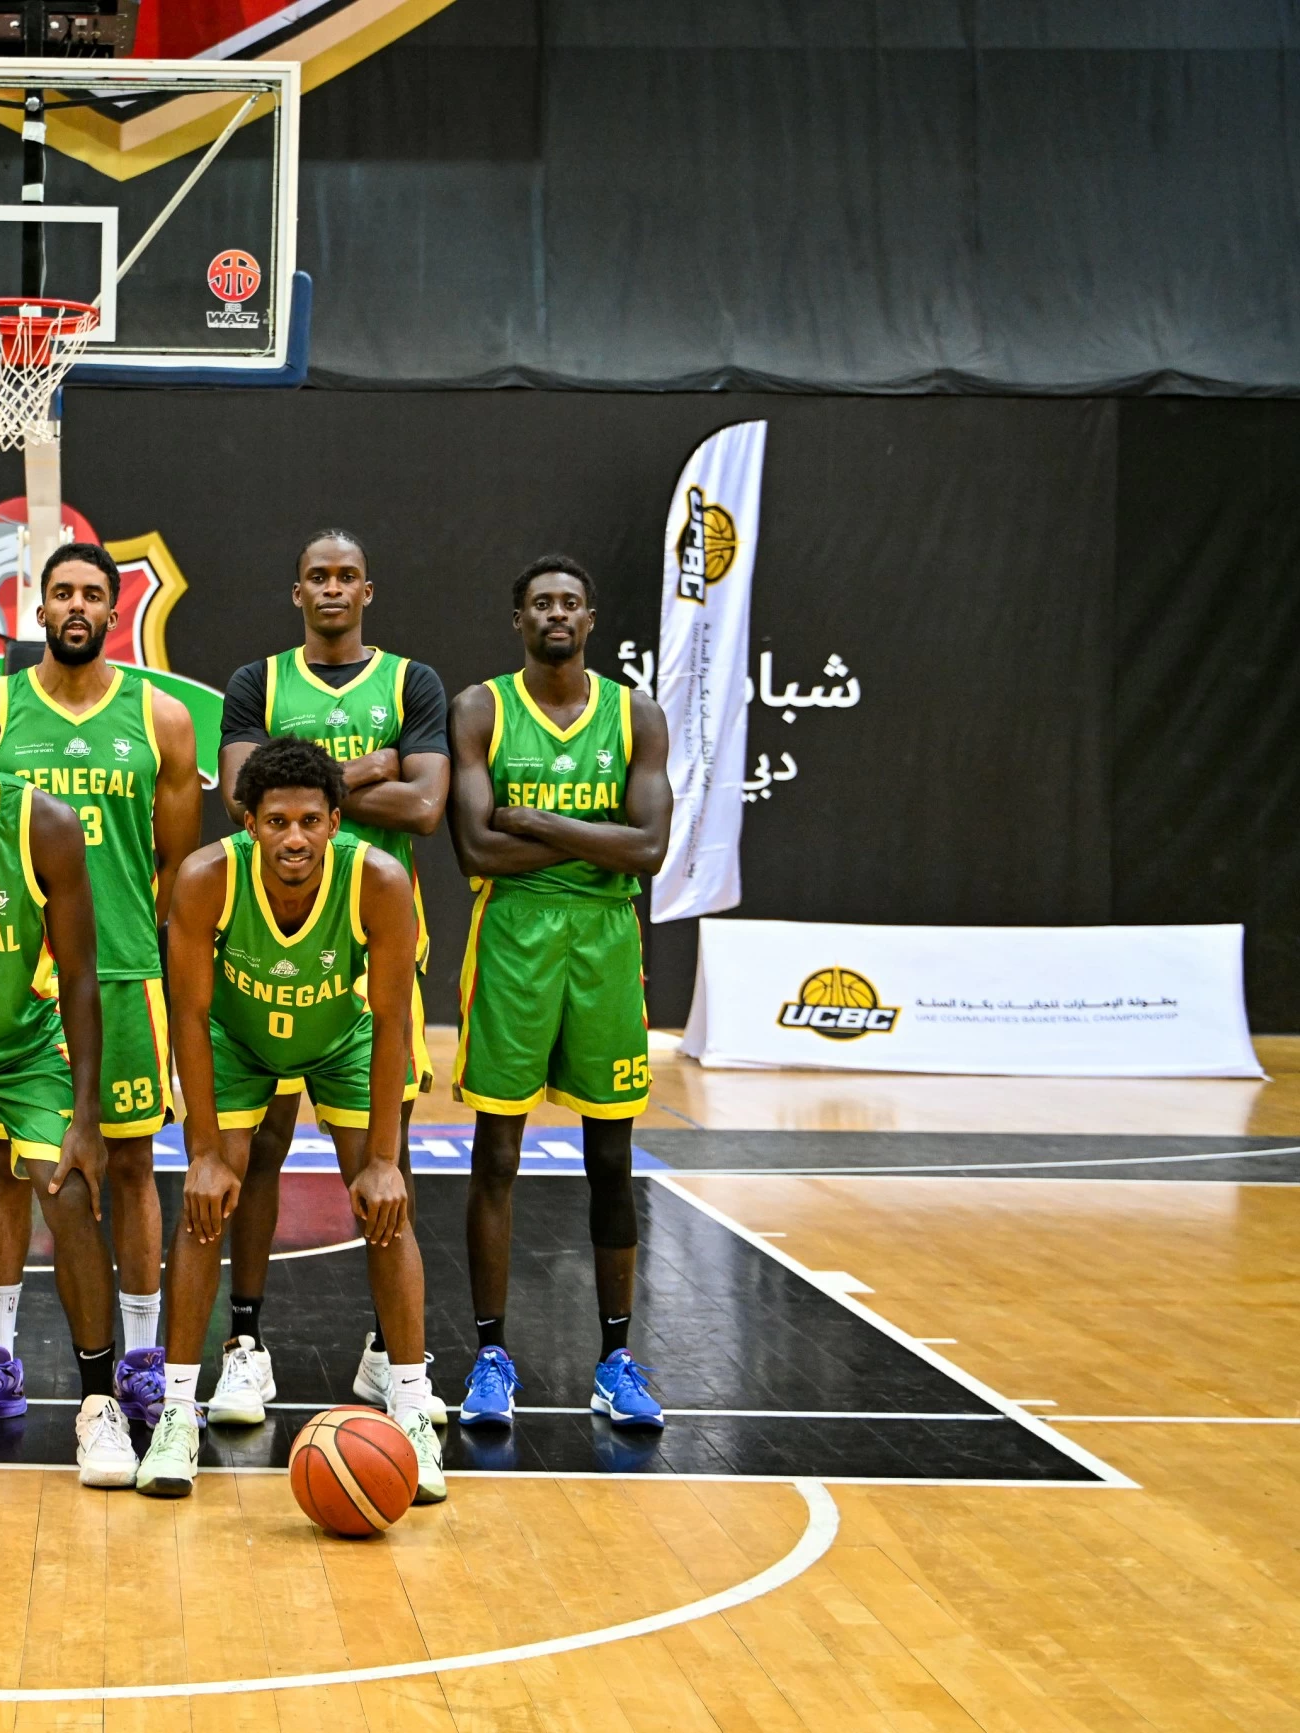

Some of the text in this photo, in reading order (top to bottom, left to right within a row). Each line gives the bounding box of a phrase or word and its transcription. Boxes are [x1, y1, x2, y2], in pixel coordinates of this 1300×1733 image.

[680, 490, 705, 601] UCBC
[745, 651, 862, 724] شبا
[508, 782, 619, 810] SENEGAL
[223, 959, 349, 1007] SENEGAL
[268, 1011, 294, 1039] 0
[781, 1005, 896, 1030] UCBC
[613, 1054, 648, 1092] 25
[112, 1077, 154, 1114] 33
